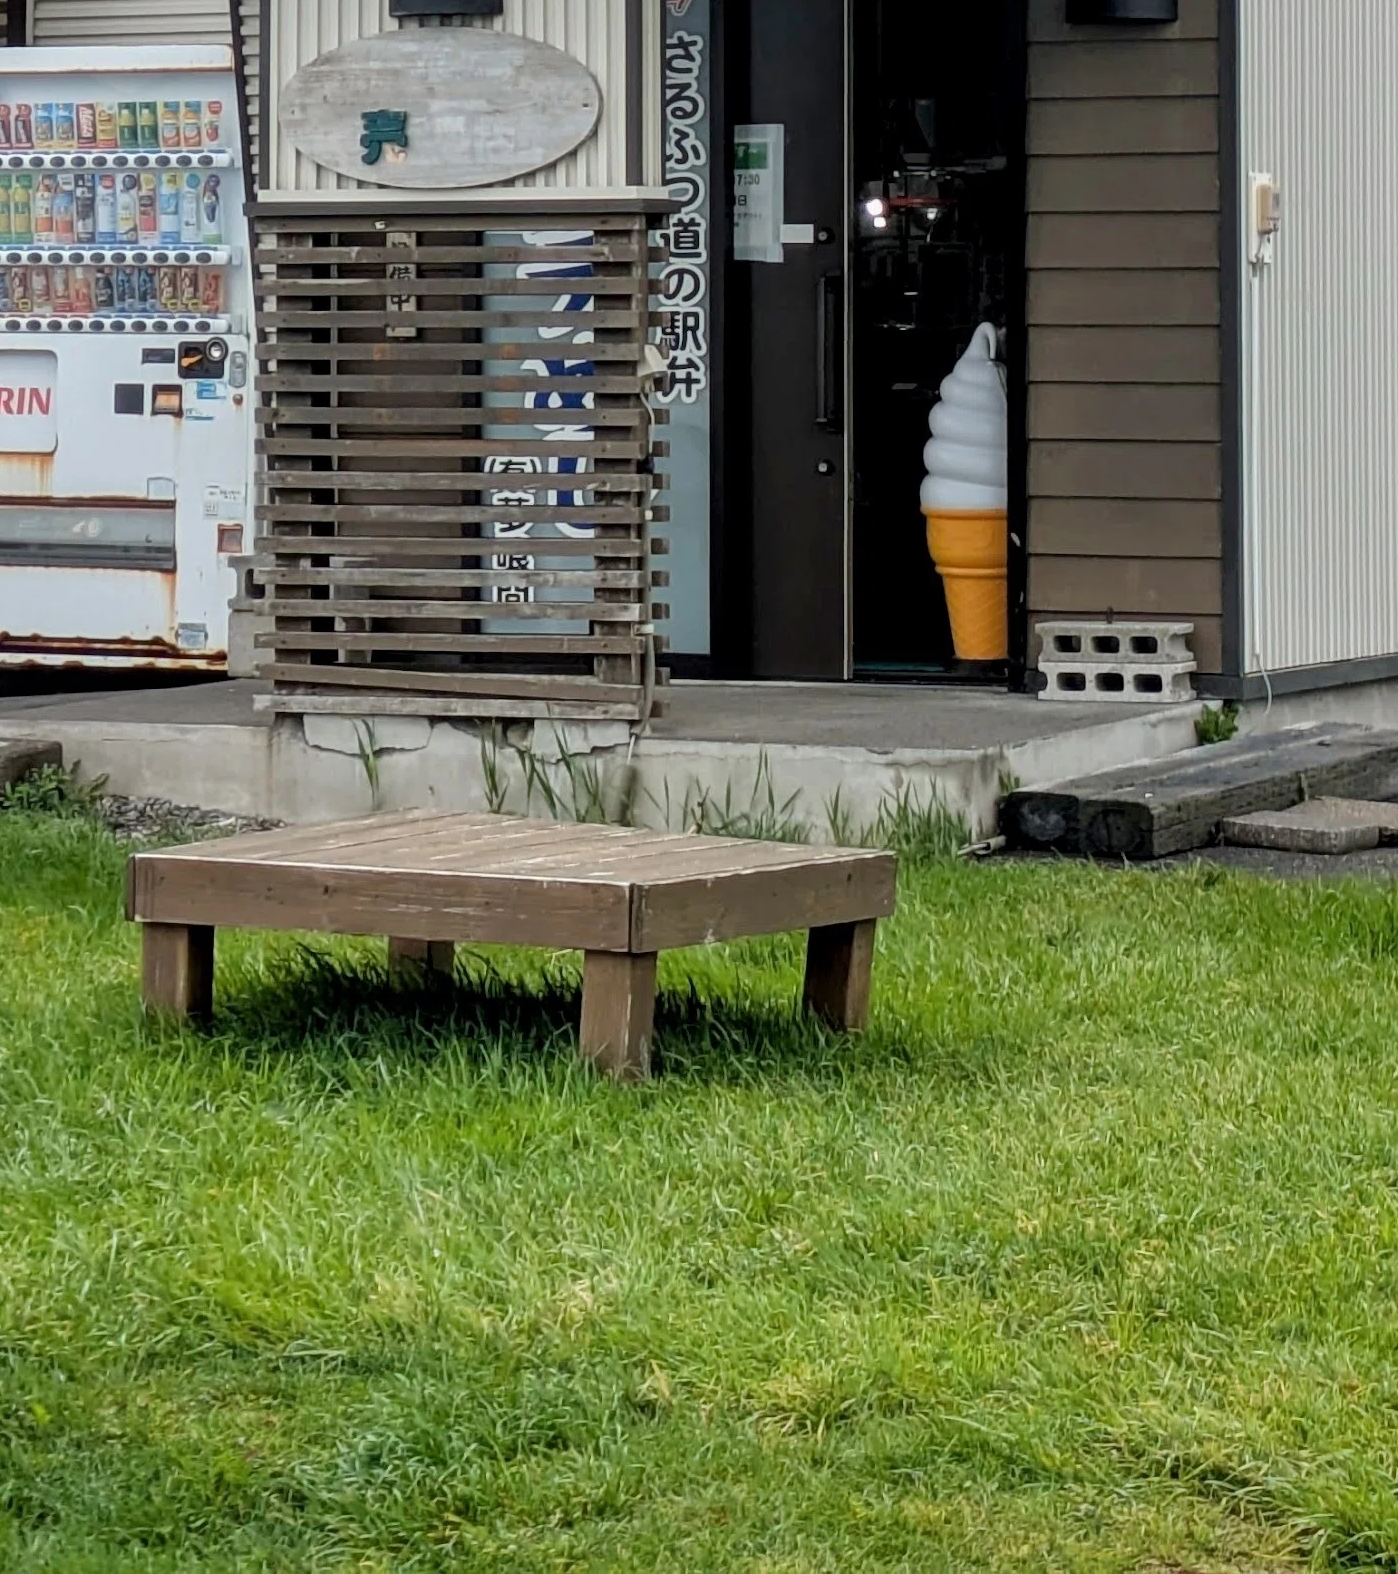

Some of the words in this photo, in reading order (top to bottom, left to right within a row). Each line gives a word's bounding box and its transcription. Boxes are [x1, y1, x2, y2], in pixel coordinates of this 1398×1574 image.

[661, 34, 703, 402] さるふつ道の駅弁
